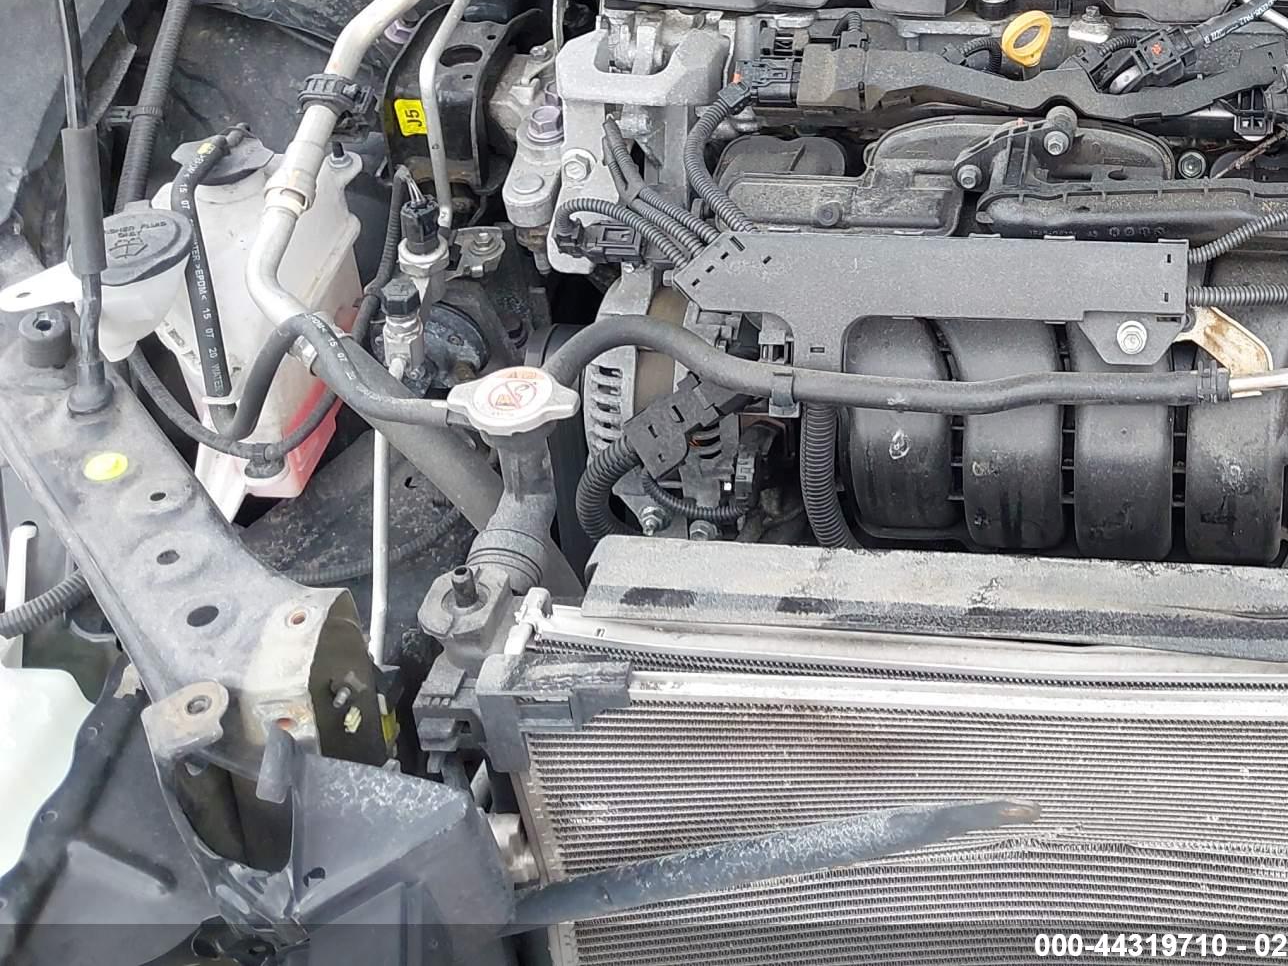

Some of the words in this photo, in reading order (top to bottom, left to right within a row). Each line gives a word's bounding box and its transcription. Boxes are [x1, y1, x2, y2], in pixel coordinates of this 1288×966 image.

[405, 109, 423, 127] J5
[179, 184, 189, 193] 15
[181, 200, 191, 210] 07
[201, 308, 212, 320] 15
[204, 328, 215, 339] 07
[208, 348, 218, 359] 20
